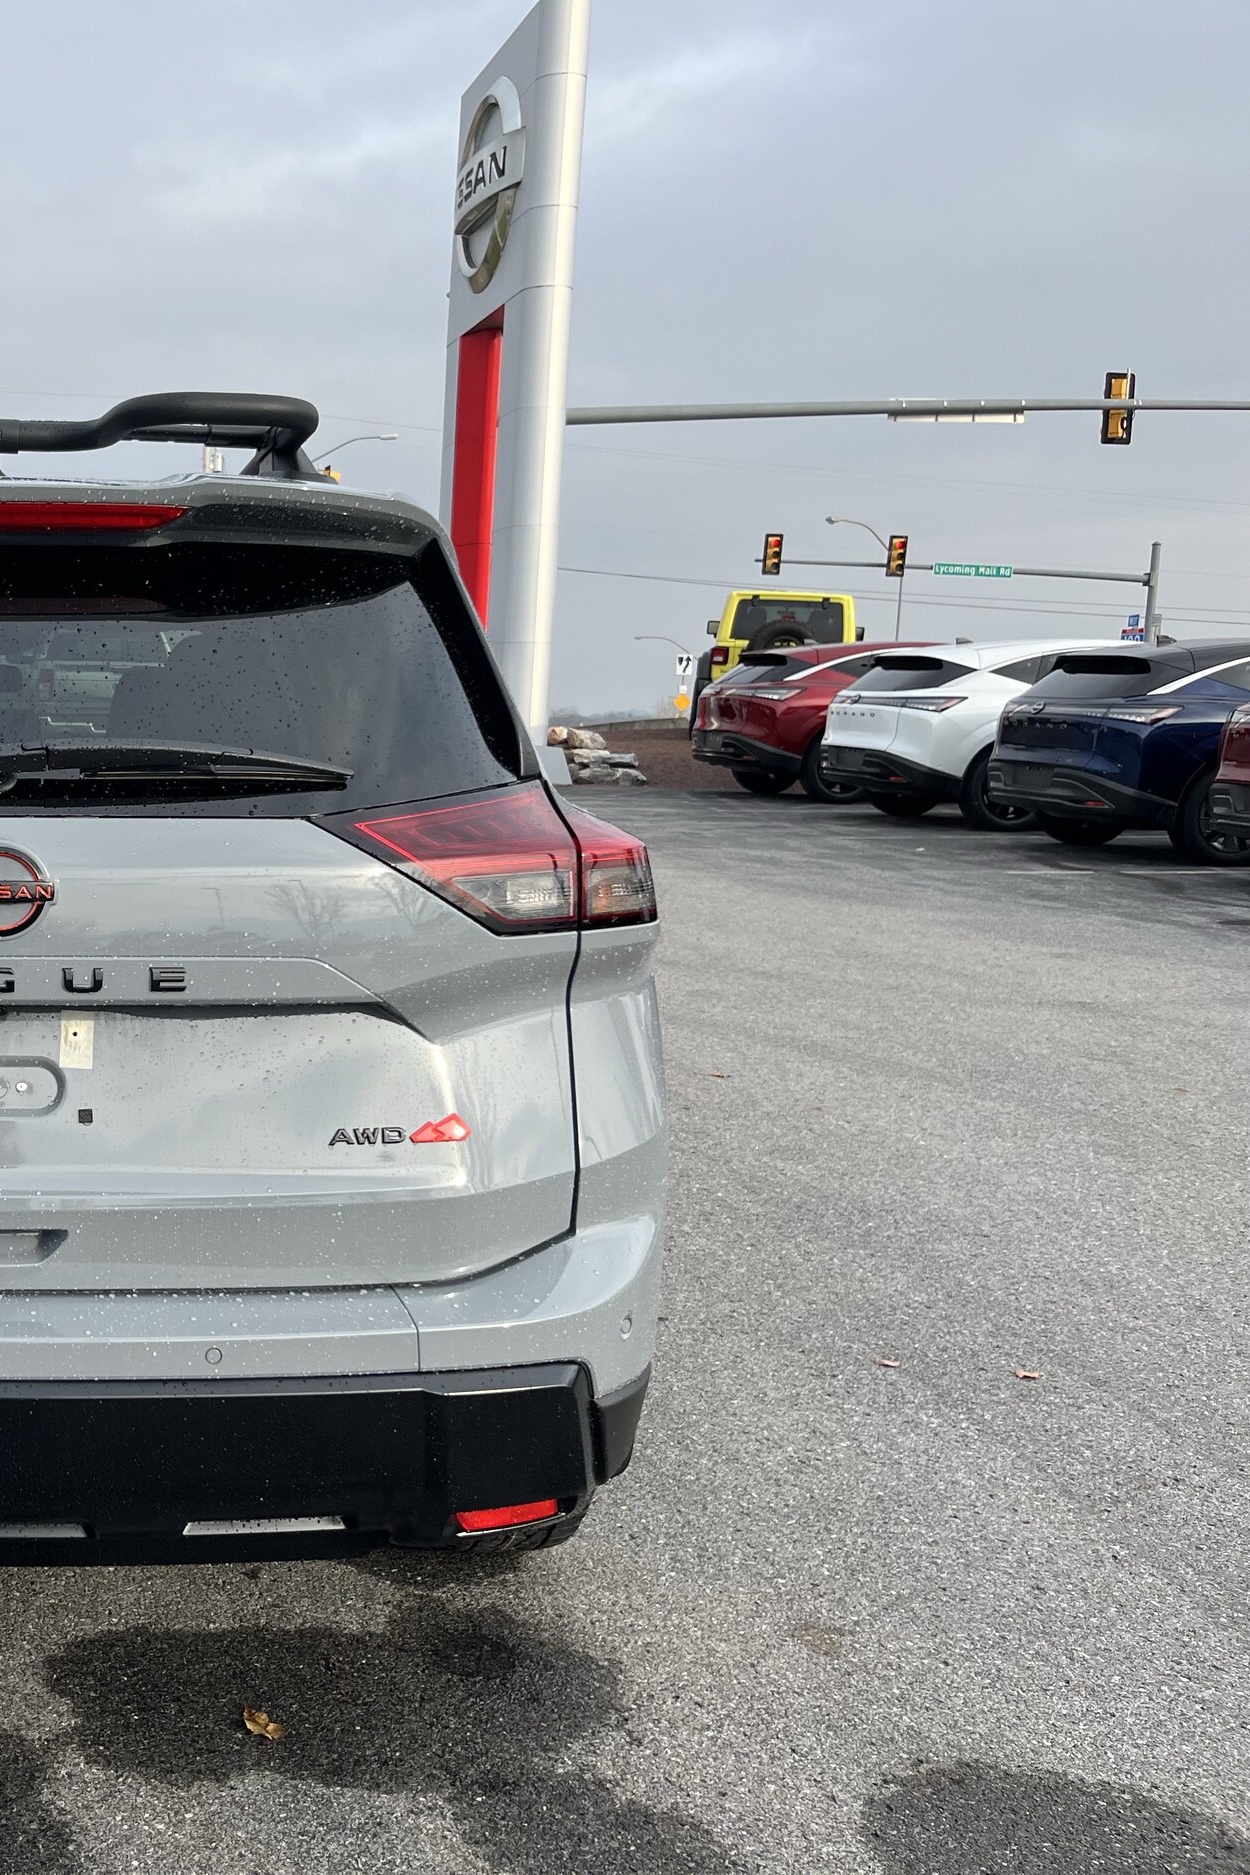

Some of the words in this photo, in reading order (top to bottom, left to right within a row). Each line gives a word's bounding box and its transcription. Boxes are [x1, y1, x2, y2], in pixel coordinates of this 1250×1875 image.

[935, 564, 975, 576] Lycoming
[978, 565, 996, 576] Mall
[999, 567, 1011, 577] Rd
[328, 1127, 406, 1146] AWD
